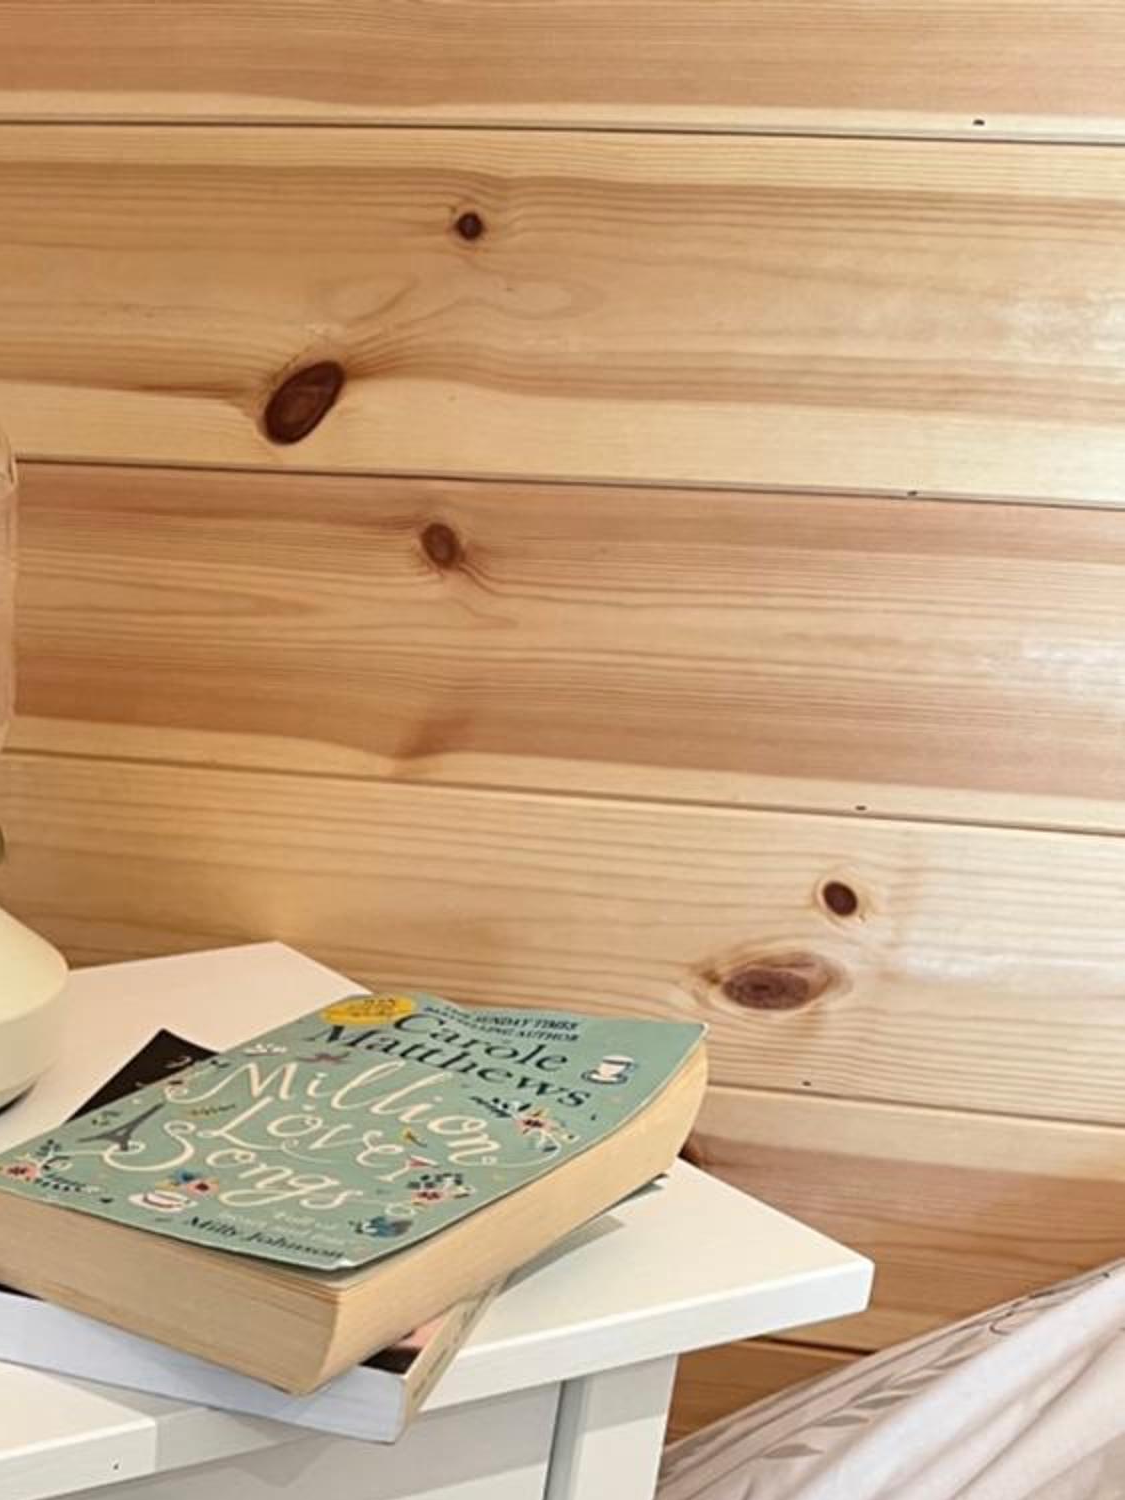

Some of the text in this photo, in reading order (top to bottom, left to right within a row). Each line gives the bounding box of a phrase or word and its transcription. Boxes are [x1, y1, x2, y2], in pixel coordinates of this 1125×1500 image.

[394, 1013, 568, 1072] Carole
[519, 1030, 579, 1041] AUTHOR
[534, 1018, 579, 1030] TIMES
[303, 1023, 591, 1108] Matthews
[163, 1058, 502, 1167] Million
[198, 1097, 405, 1169] Love
[101, 1120, 363, 1210] Songs
